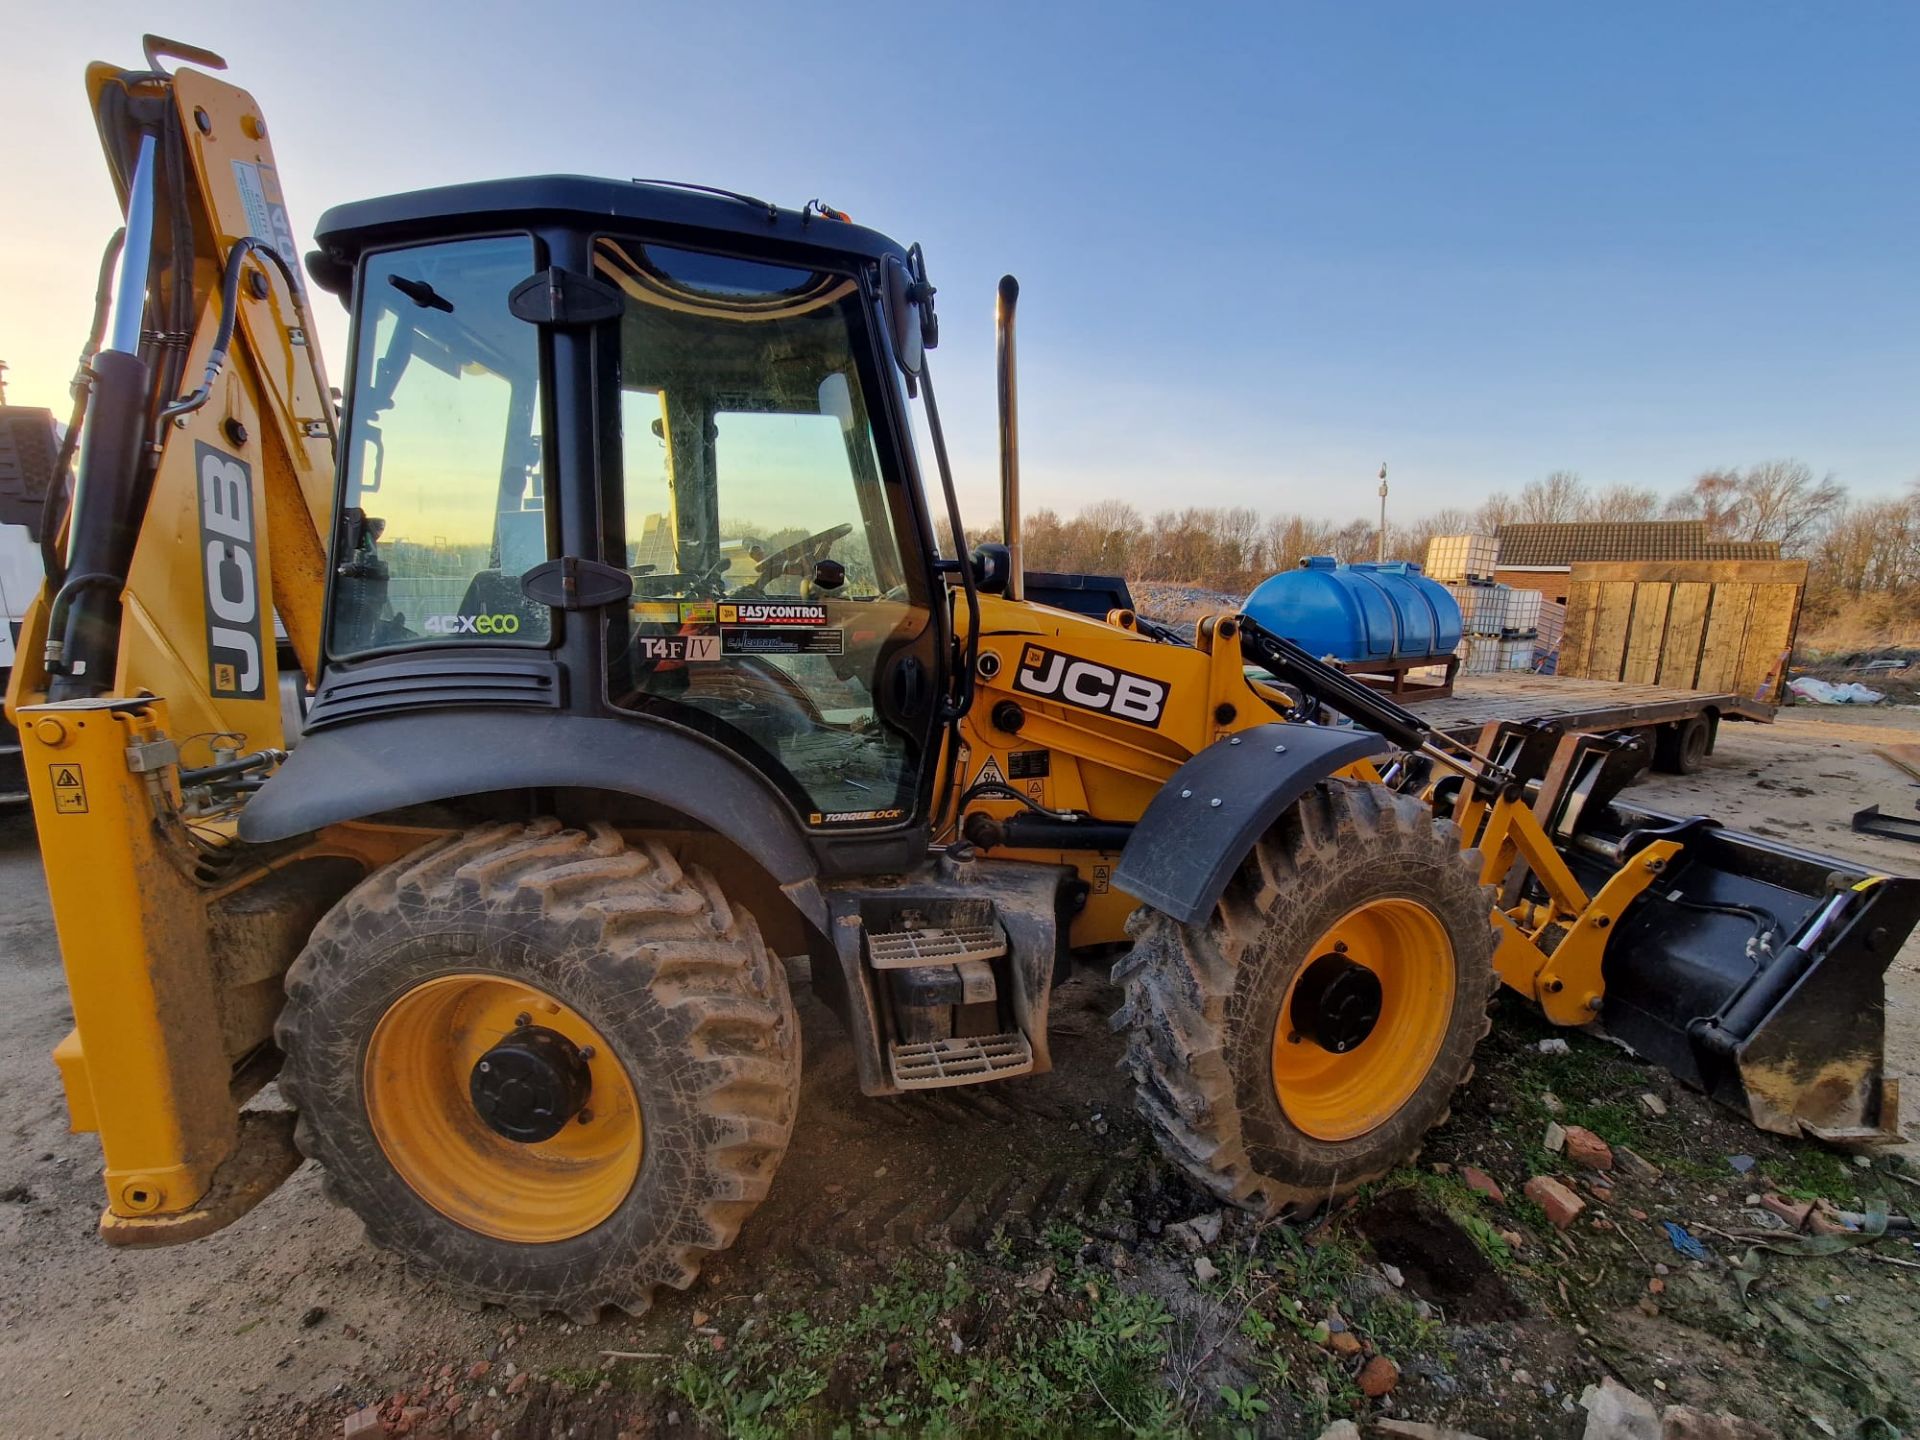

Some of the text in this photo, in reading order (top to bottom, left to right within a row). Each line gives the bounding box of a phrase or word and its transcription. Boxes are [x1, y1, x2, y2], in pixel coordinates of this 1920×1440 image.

[202, 454, 260, 692] JCB
[738, 605, 826, 621] EASYCONTROL
[1020, 655, 1164, 722] JCB
